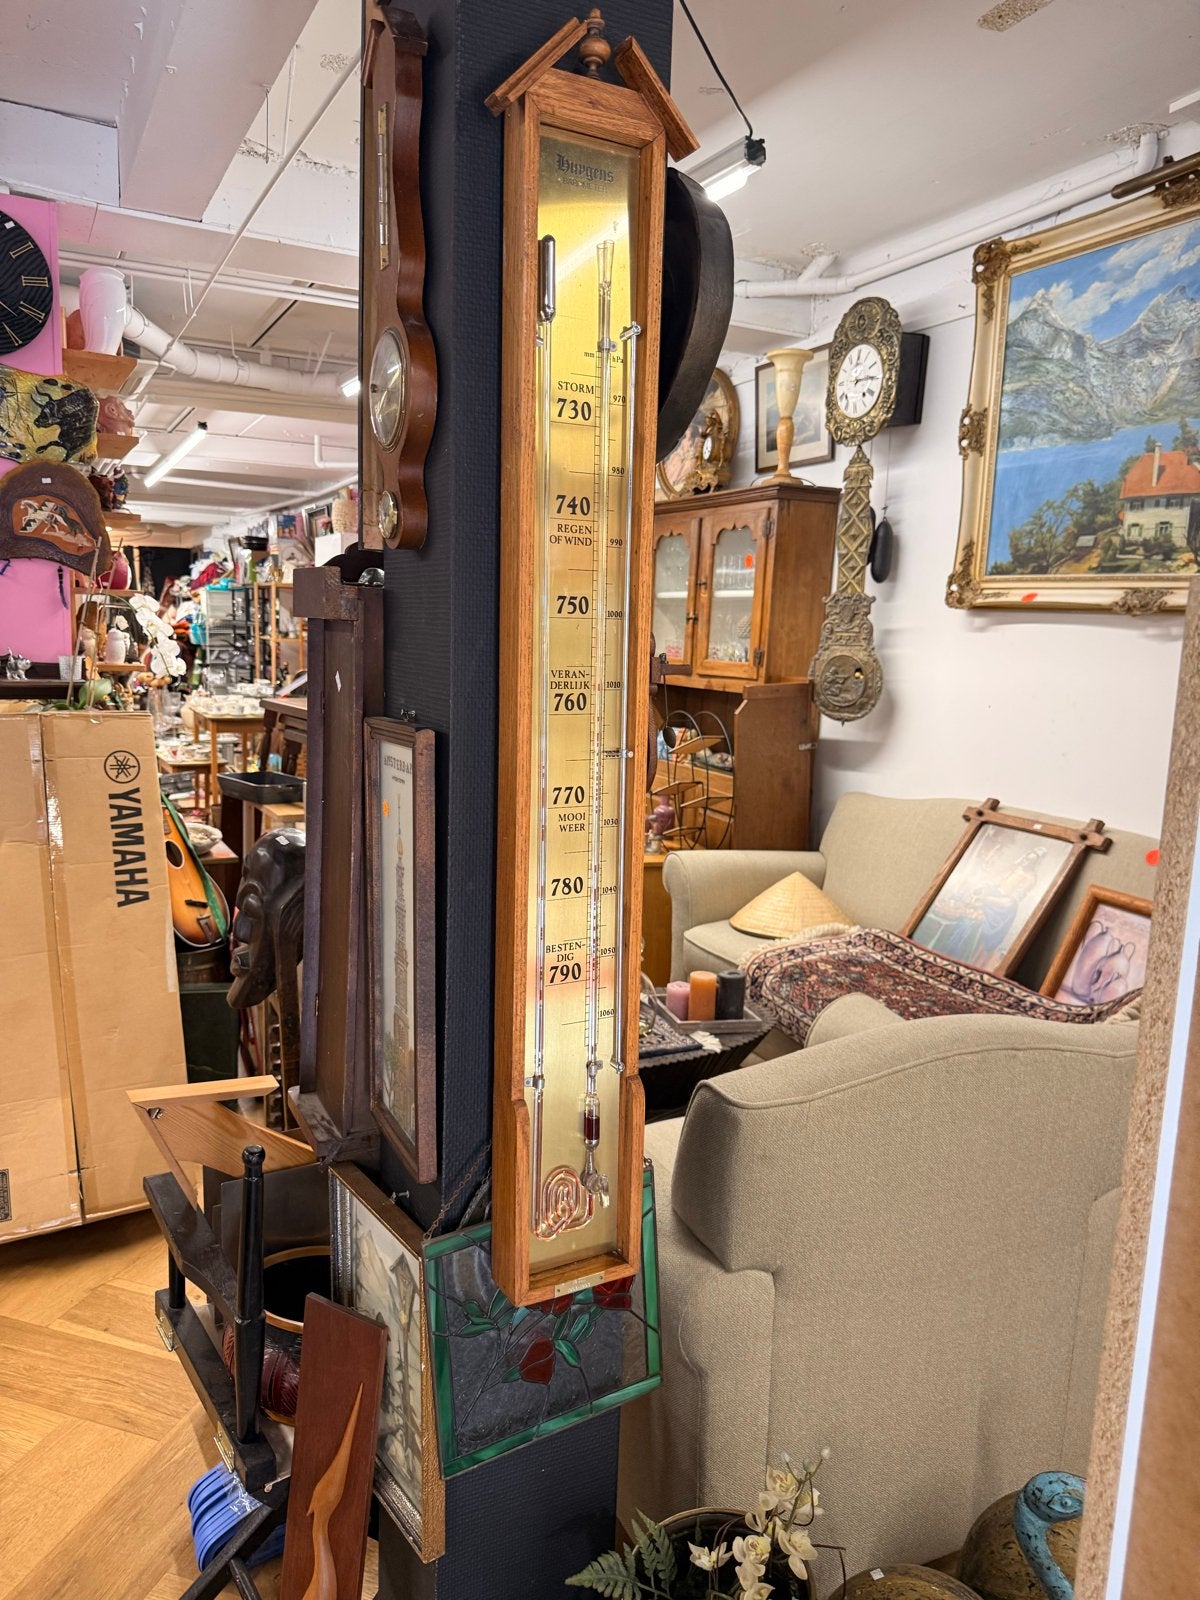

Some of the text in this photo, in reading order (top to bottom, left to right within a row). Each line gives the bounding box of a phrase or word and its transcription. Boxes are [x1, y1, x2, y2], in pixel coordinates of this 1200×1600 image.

[557, 380, 594, 395] STORM
[612, 394, 626, 404] 970
[556, 397, 592, 421] 730
[555, 494, 591, 516] 740
[557, 523, 592, 535] REGEN
[549, 534, 592, 547] OF WIND
[609, 538, 623, 547] 990
[556, 595, 590, 615] 750
[607, 610, 623, 619] 1000
[551, 669, 590, 679] VERAN-
[550, 680, 590, 690] DERLIJK
[606, 681, 621, 689] 1010
[553, 692, 587, 712] 760
[552, 785, 585, 805] 770
[558, 812, 586, 822] MOOI
[603, 818, 619, 826] 1030
[559, 823, 586, 833] WEER
[108, 787, 150, 908] YAMAHA
[551, 876, 584, 897] 780
[602, 885, 617, 894] 1040
[545, 941, 586, 954] BESTEN-
[600, 947, 616, 955] 1050
[556, 952, 574, 963] DIG
[549, 962, 581, 984] 790
[599, 1008, 615, 1017] 1060
